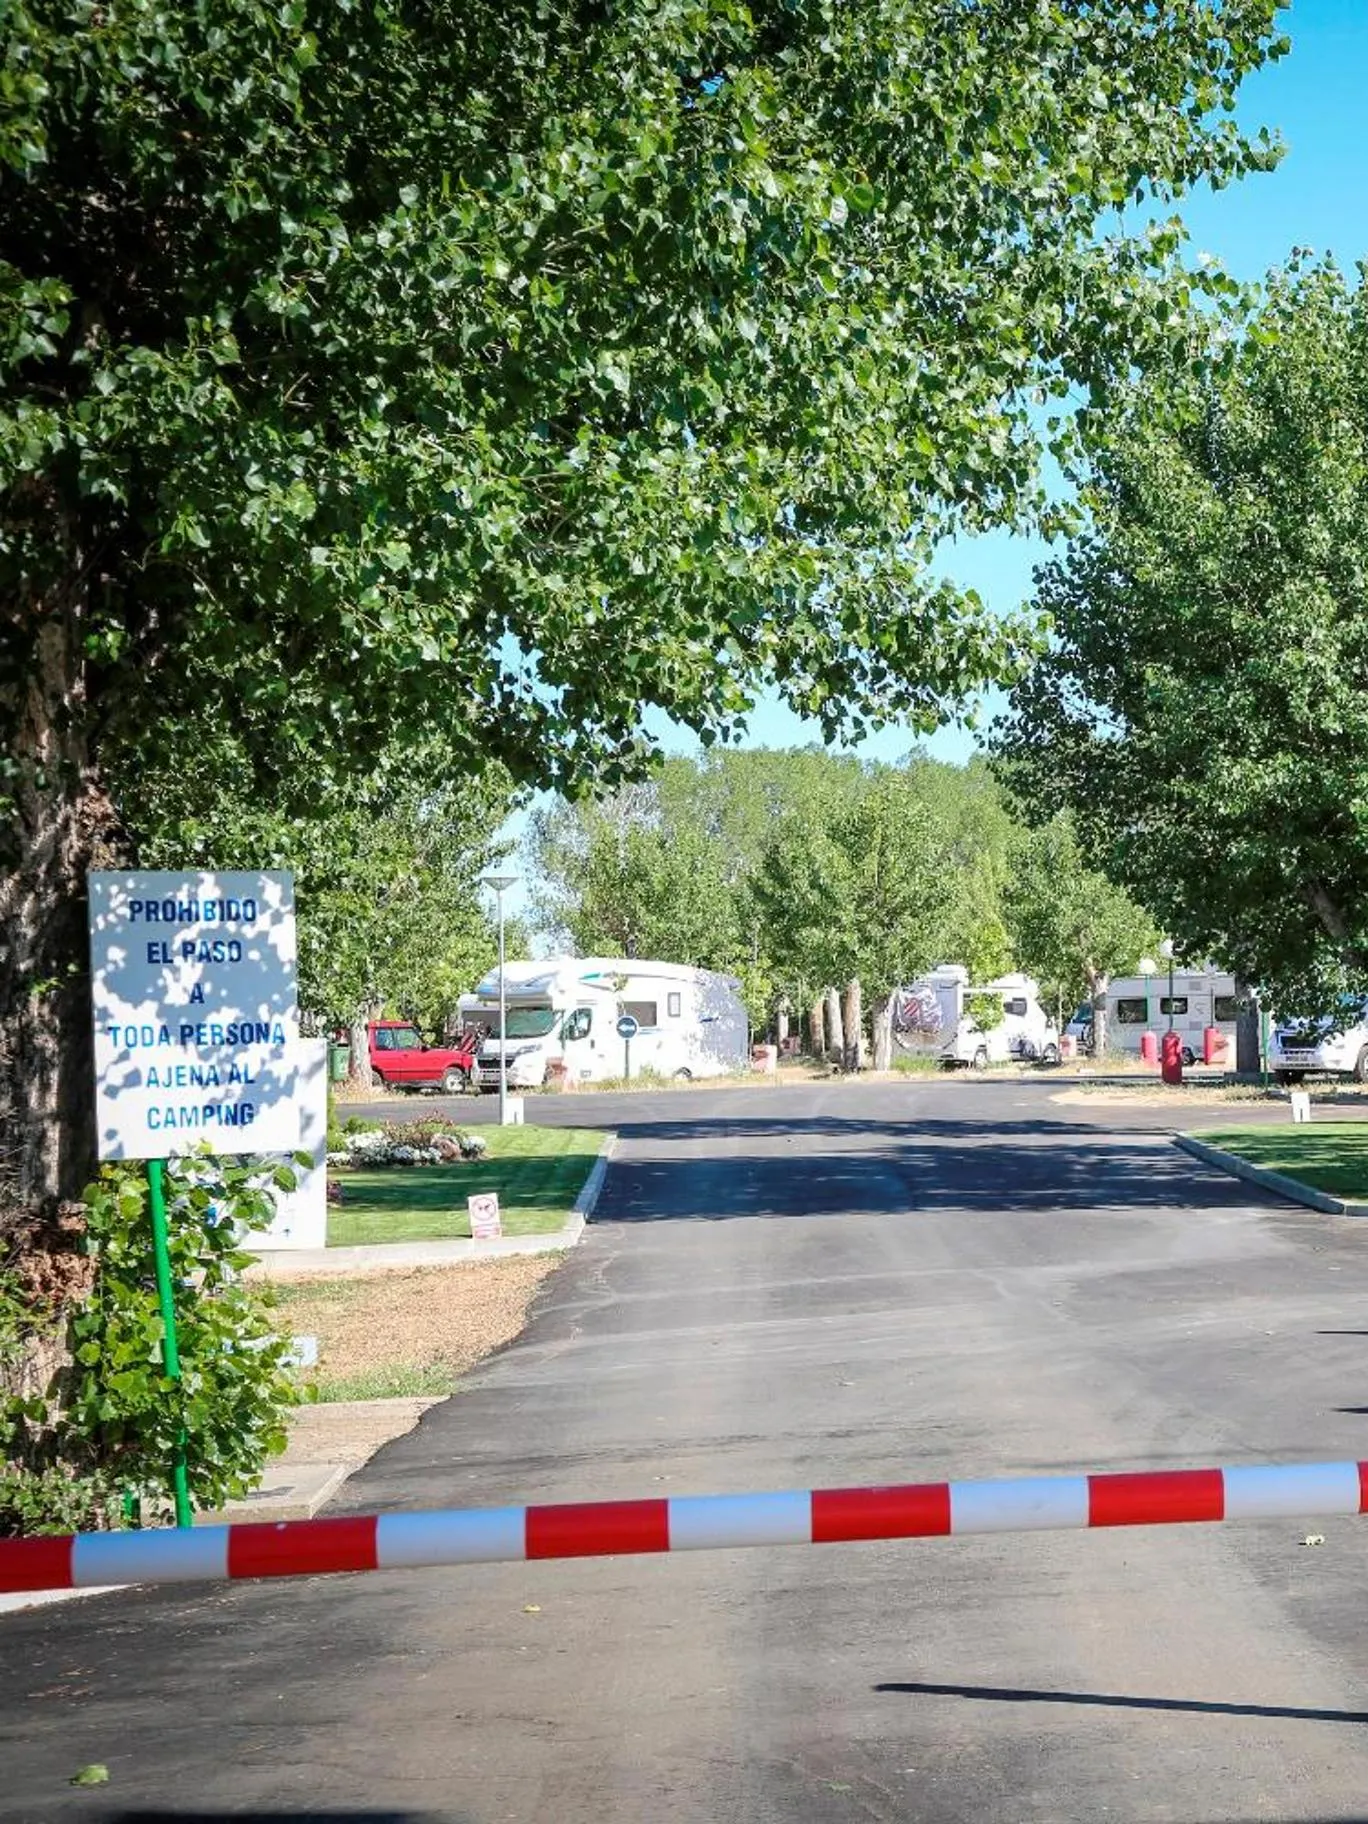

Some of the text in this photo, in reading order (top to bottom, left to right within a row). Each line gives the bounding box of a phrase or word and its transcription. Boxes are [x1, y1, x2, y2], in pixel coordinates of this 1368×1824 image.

[128, 899, 257, 923] PROHIBIDO
[147, 940, 242, 965] EL PASO
[189, 982, 205, 1004] A
[108, 1022, 286, 1048] TODA PERSONA
[146, 1063, 255, 1088] AJENA AL
[147, 1103, 255, 1130] CAMPING
